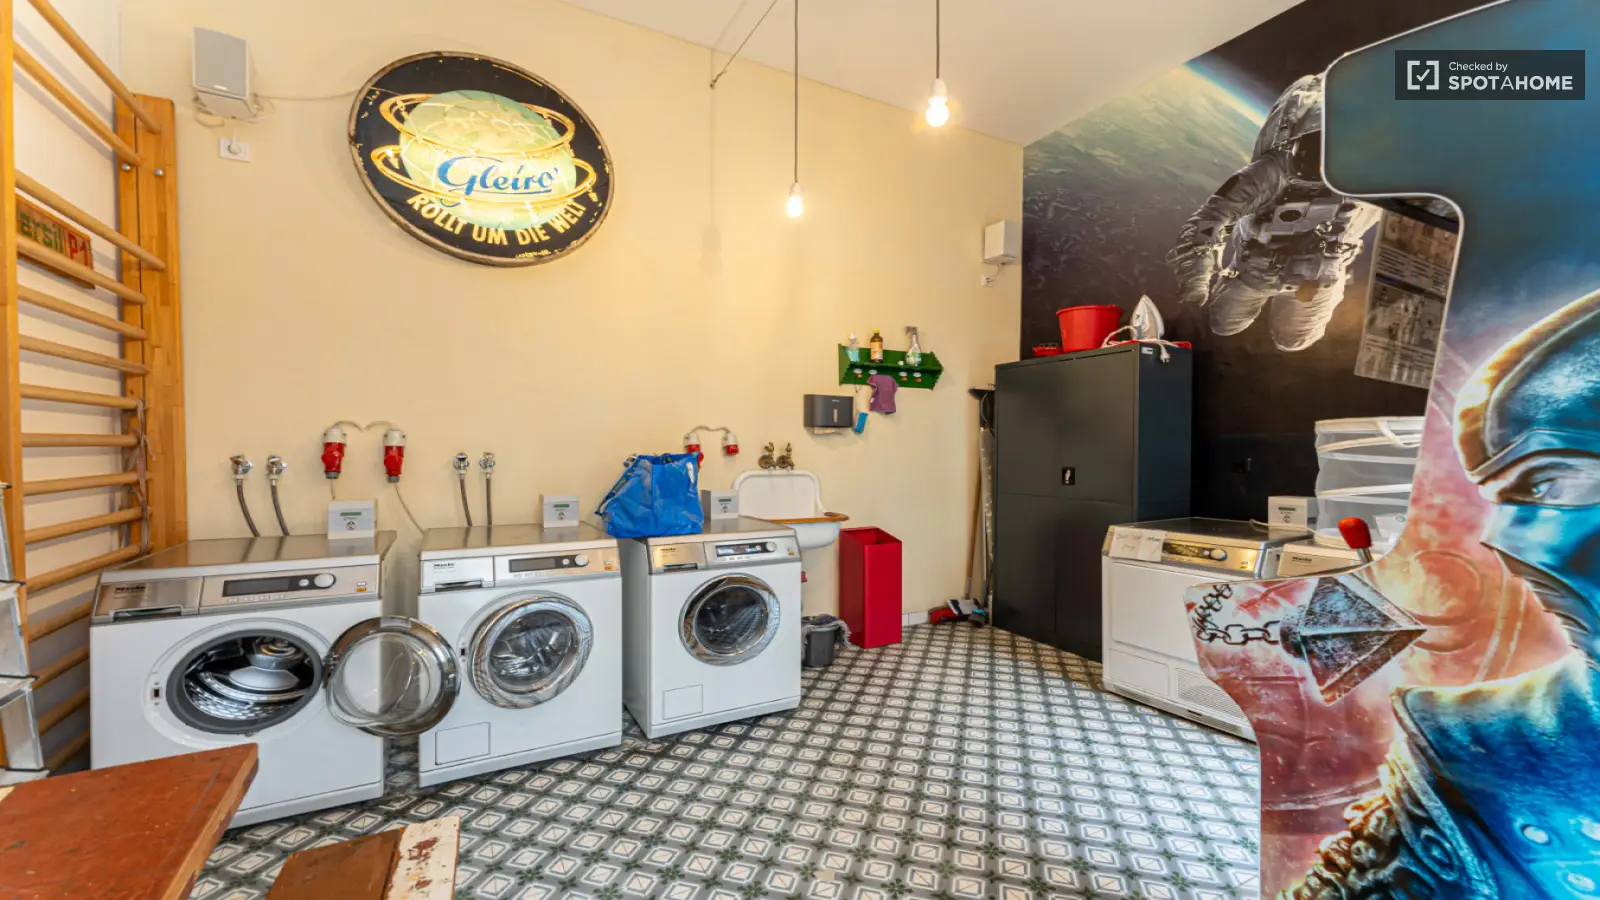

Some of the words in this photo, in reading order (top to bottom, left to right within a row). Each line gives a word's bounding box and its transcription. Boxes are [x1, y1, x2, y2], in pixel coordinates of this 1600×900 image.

[20, 211, 64, 254] ersil
[407, 194, 468, 235] ROLLT
[472, 226, 508, 245] UM
[515, 225, 550, 245] DIE
